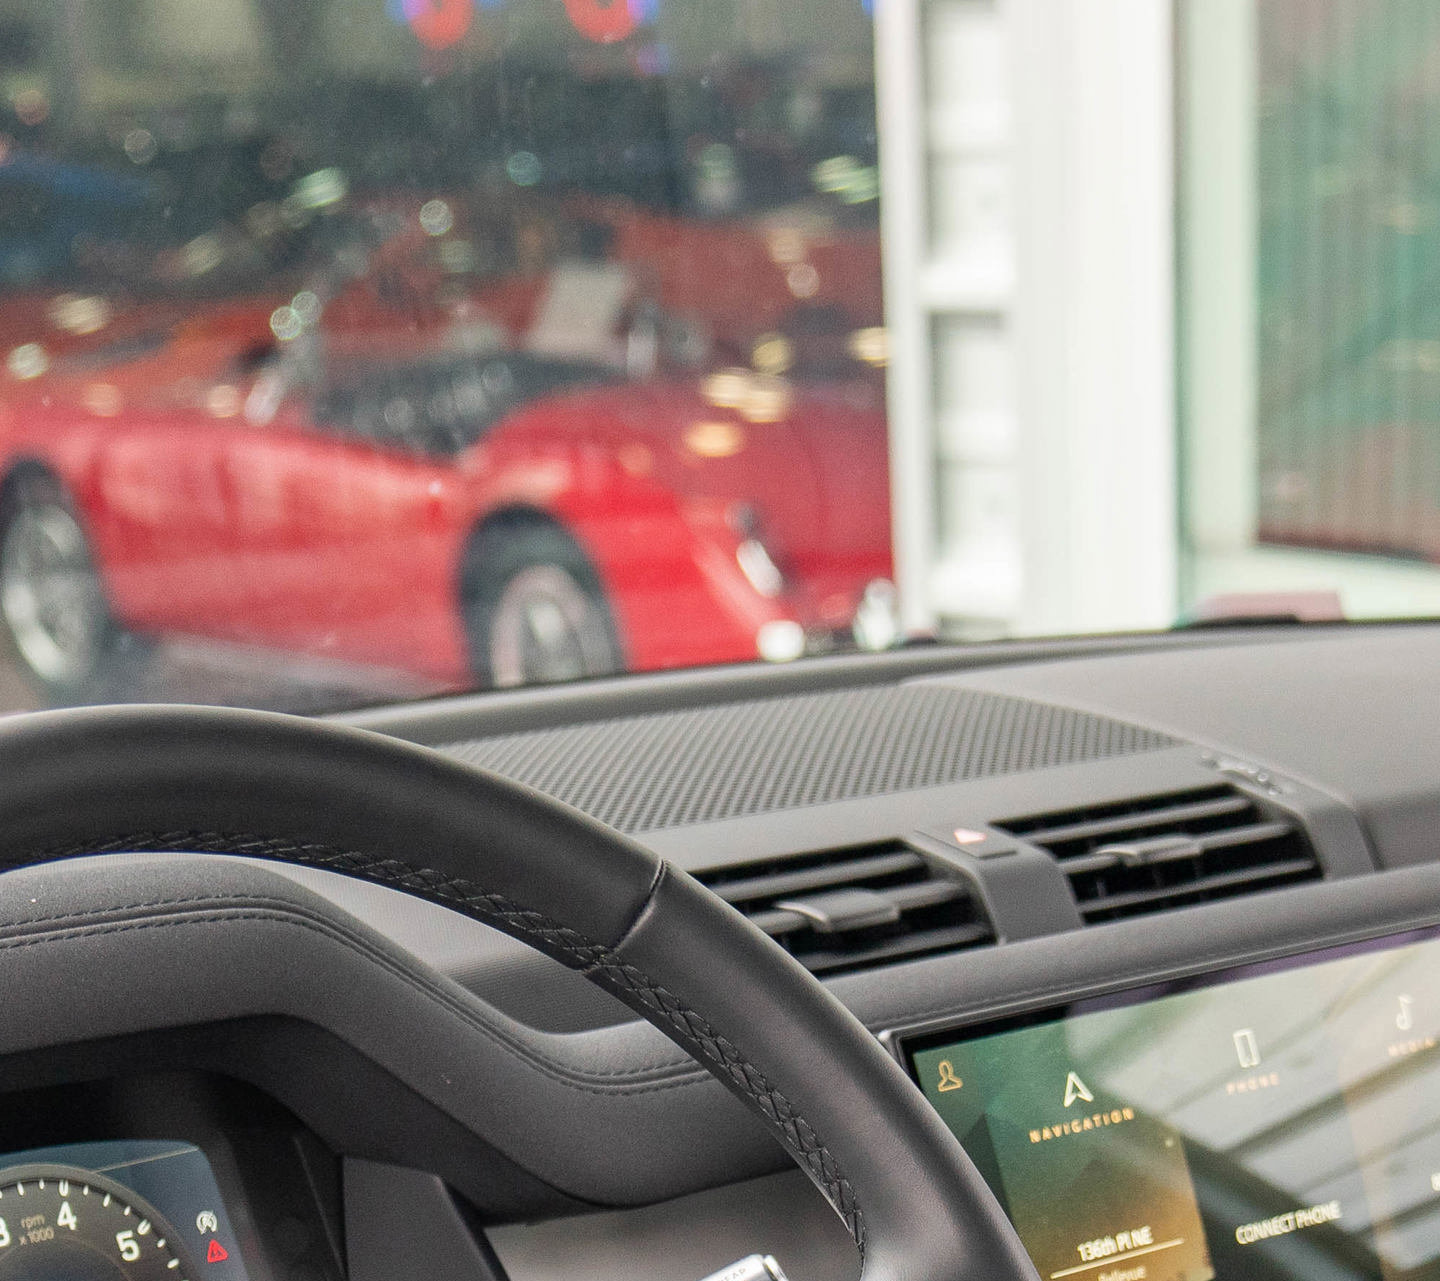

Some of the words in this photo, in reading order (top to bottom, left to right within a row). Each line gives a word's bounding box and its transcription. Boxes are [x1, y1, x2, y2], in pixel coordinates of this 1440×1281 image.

[1225, 1073, 1281, 1096] PHONE
[1029, 1106, 1135, 1144] NAVIGATION
[21, 1214, 46, 1230] rpm
[56, 1201, 77, 1230] 4
[1235, 1211, 1296, 1245] CONNECT
[1295, 1200, 1342, 1230] PHONE
[115, 1230, 140, 1262] 5
[1131, 1225, 1154, 1248] NE
